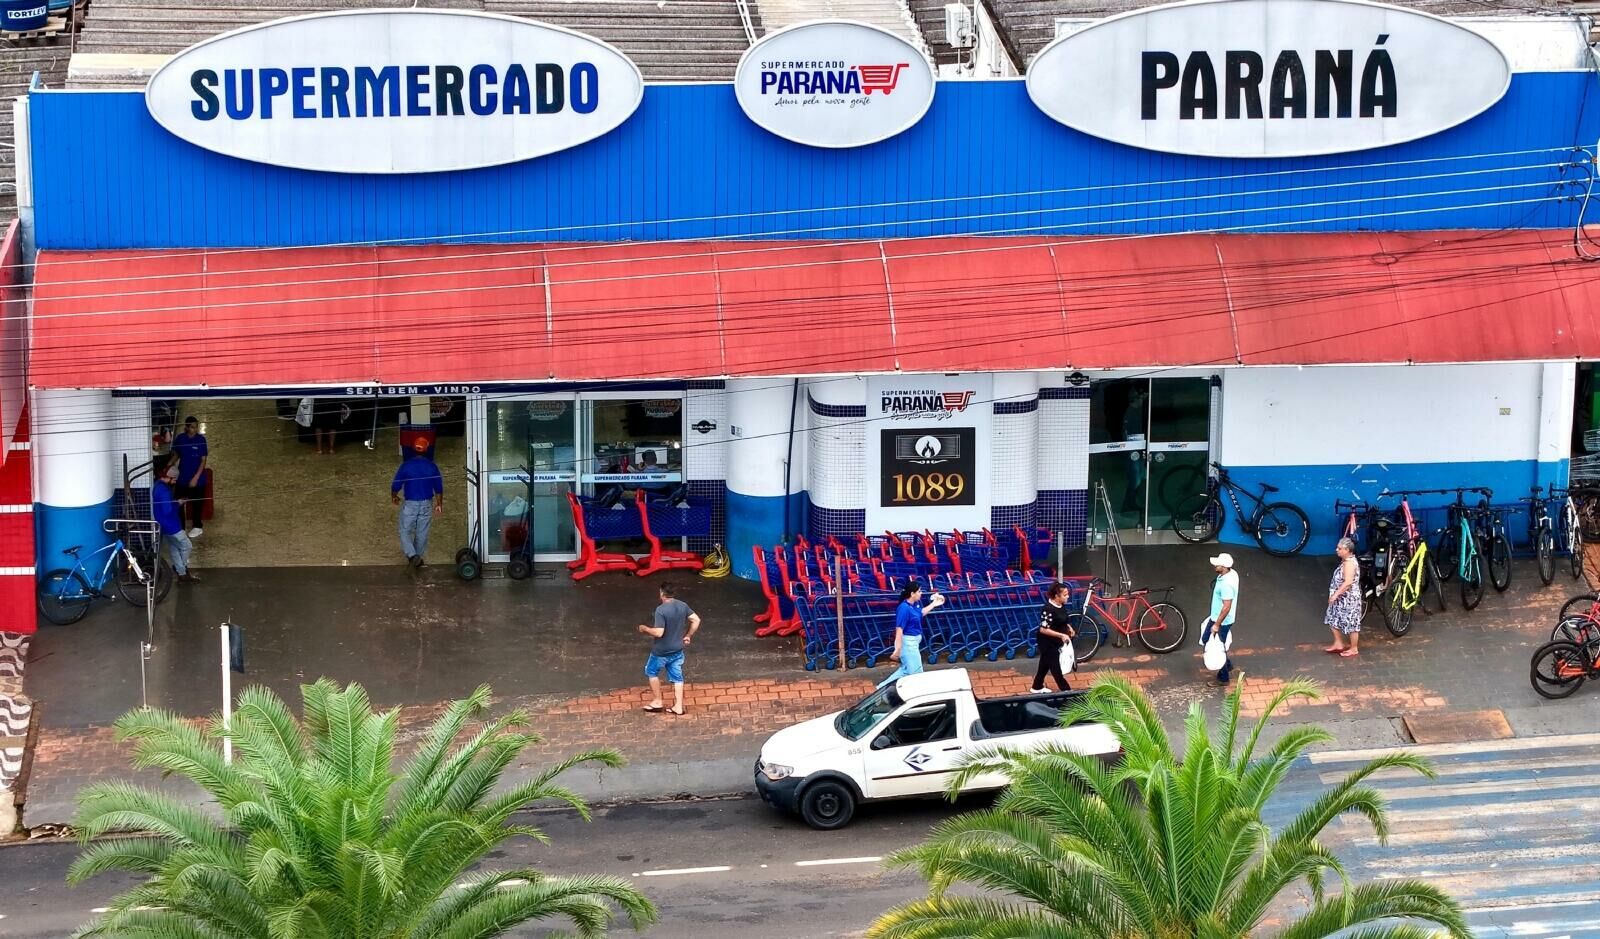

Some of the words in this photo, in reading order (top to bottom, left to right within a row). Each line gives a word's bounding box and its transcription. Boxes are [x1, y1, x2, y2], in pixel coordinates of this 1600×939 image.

[9, 7, 46, 18] FORTLEV
[761, 60, 845, 69] SUPERMERCADO
[761, 65, 861, 95] PARANÁ
[1141, 34, 1398, 121] PARANÁ
[190, 62, 599, 121] SUPERMERCADO
[774, 97, 798, 106] Amor
[802, 95, 820, 107] pela
[387, 386, 418, 394] BEM
[434, 385, 481, 394] VINDO
[881, 393, 944, 413] PARANÁ
[892, 472, 964, 502] 1089
